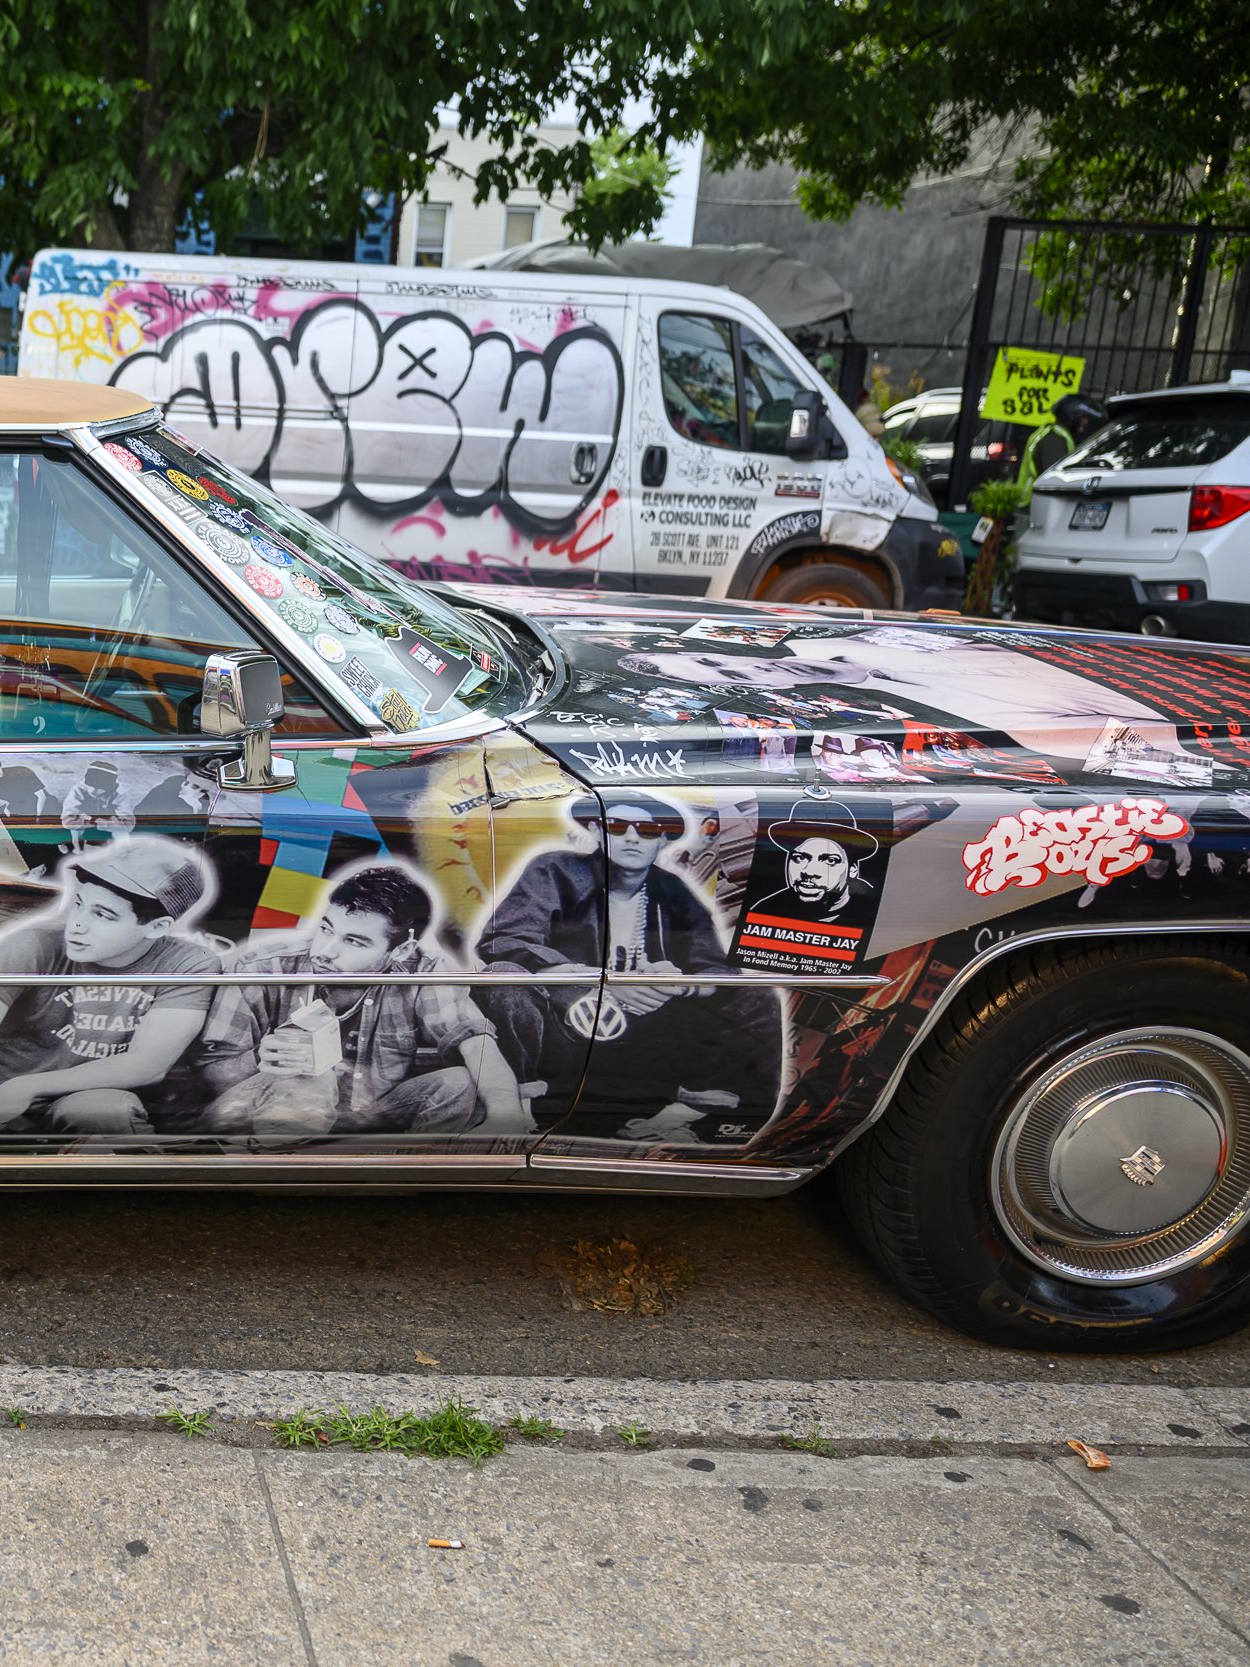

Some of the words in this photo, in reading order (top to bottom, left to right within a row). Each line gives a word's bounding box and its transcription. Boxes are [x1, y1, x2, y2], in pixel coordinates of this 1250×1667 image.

[642, 491, 685, 508] ELEVATE
[686, 494, 717, 510] FOOD
[718, 494, 758, 512] DESIGN
[658, 510, 730, 528] CONSULTING
[731, 513, 753, 529] LLC
[661, 533, 687, 549] SCOTT
[725, 535, 740, 550] 121
[688, 551, 702, 566] NY
[702, 551, 729, 568] 11237
[743, 924, 772, 937] JAM
[774, 929, 830, 947] MASTER
[833, 938, 860, 950] JAY
[736, 947, 756, 957] Jason
[757, 950, 779, 960] Mizell
[799, 957, 814, 966] Jam
[815, 959, 840, 969] Master
[840, 962, 853, 971] Jay
[752, 957, 769, 966] Fond
[770, 959, 799, 971] Memory
[800, 964, 817, 973] 1965
[823, 967, 842, 976] 2002
